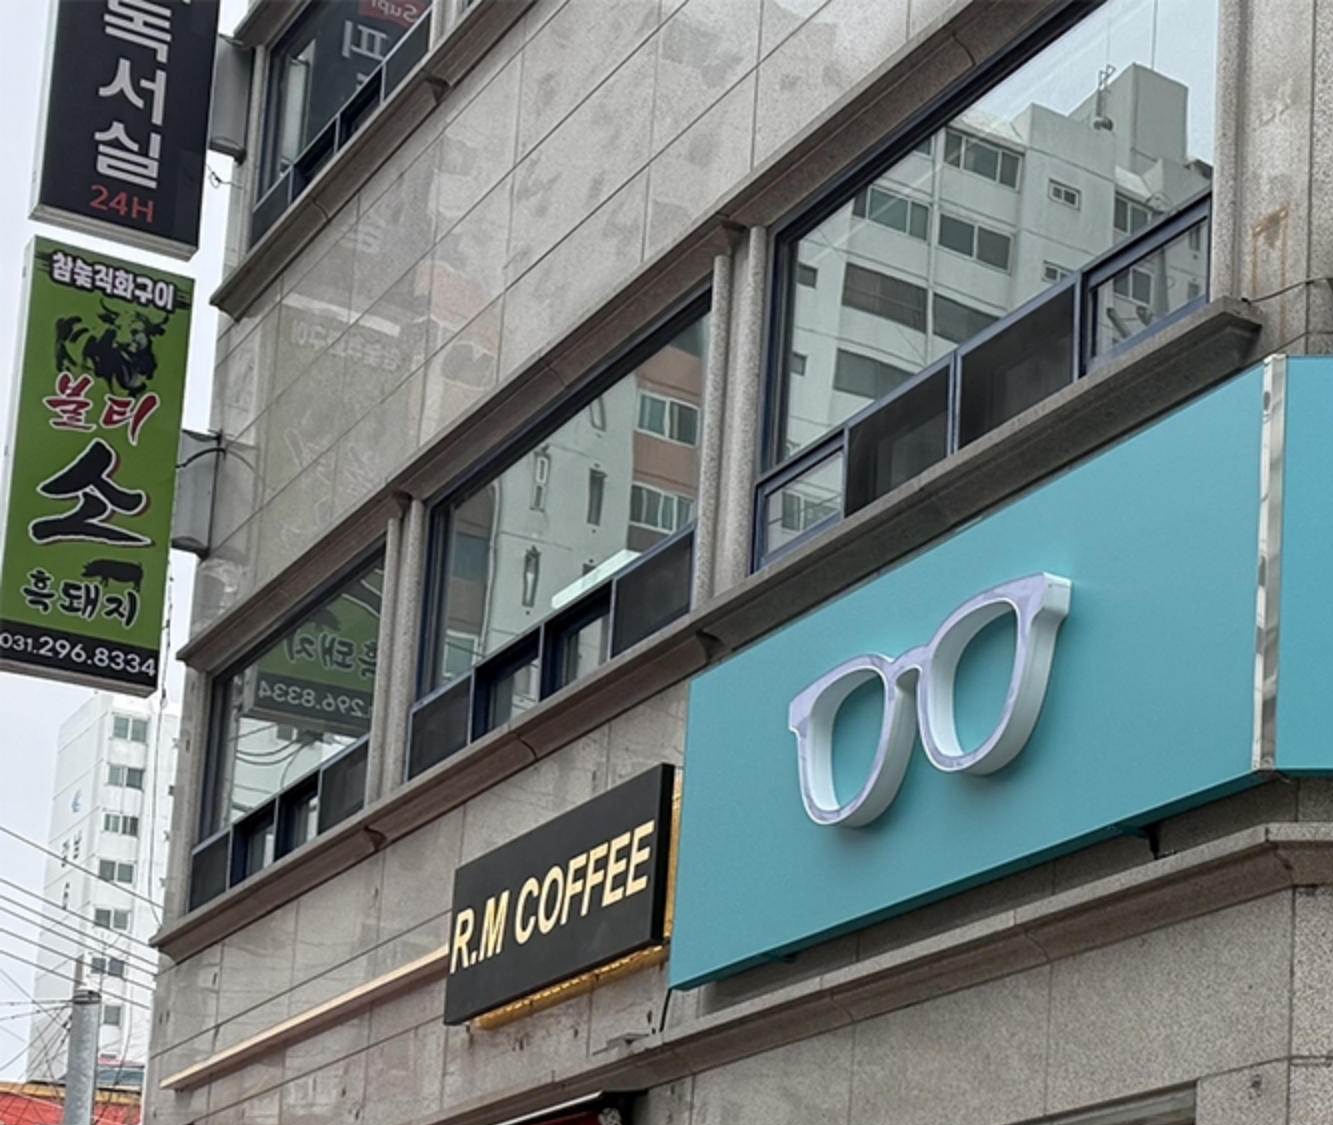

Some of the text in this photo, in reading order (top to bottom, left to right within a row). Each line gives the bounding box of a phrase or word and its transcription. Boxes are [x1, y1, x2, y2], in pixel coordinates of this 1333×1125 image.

[90, 184, 154, 222] 24H
[28, 439, 150, 547] 소
[21, 567, 139, 630] 흑돼지
[0, 632, 156, 677] 031.296.8334
[449, 821, 655, 973] R.M COFFEE
